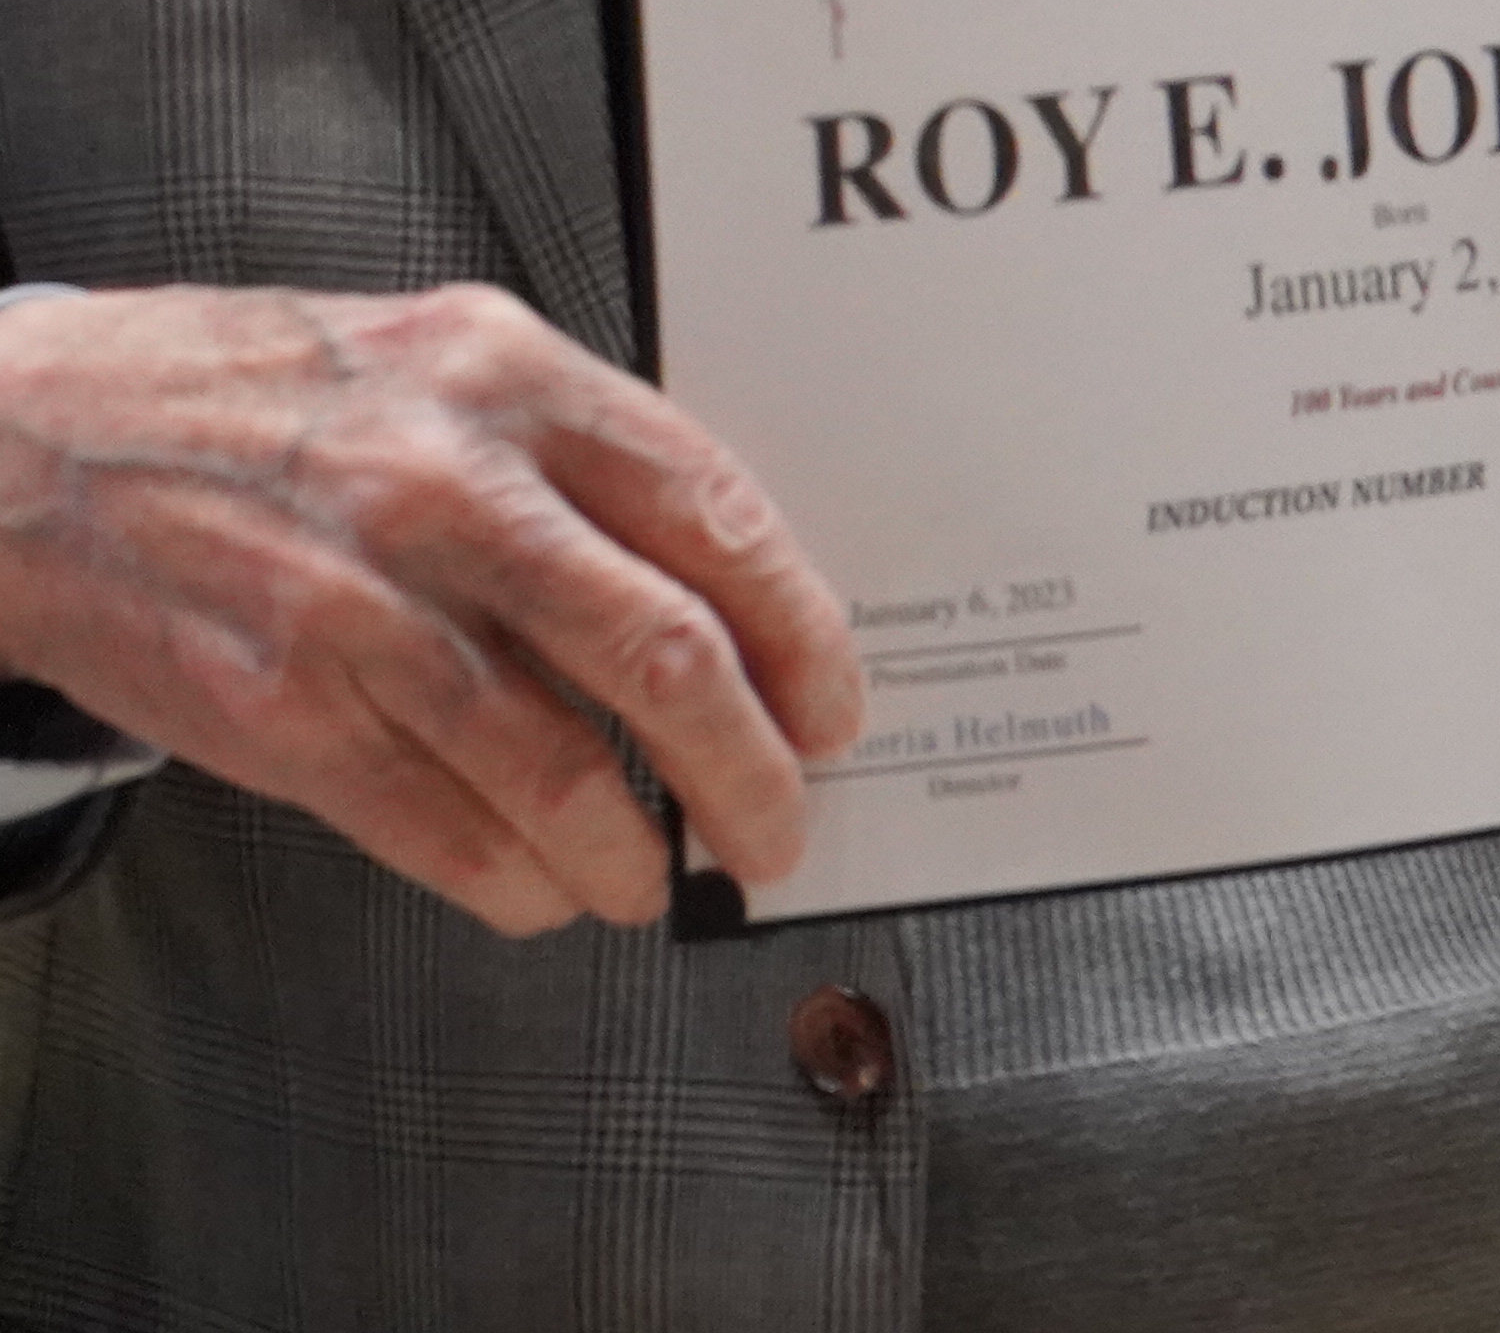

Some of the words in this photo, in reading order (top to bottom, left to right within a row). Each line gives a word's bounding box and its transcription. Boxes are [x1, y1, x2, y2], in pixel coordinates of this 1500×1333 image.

[808, 87, 1114, 228] ROY
[1159, 75, 1286, 191] E.
[1244, 259, 1435, 321] January
[1453, 236, 1500, 294] 2,
[1403, 371, 1449, 404] and
[1145, 481, 1341, 535] INDUCTION
[1351, 460, 1486, 507] NUMBER
